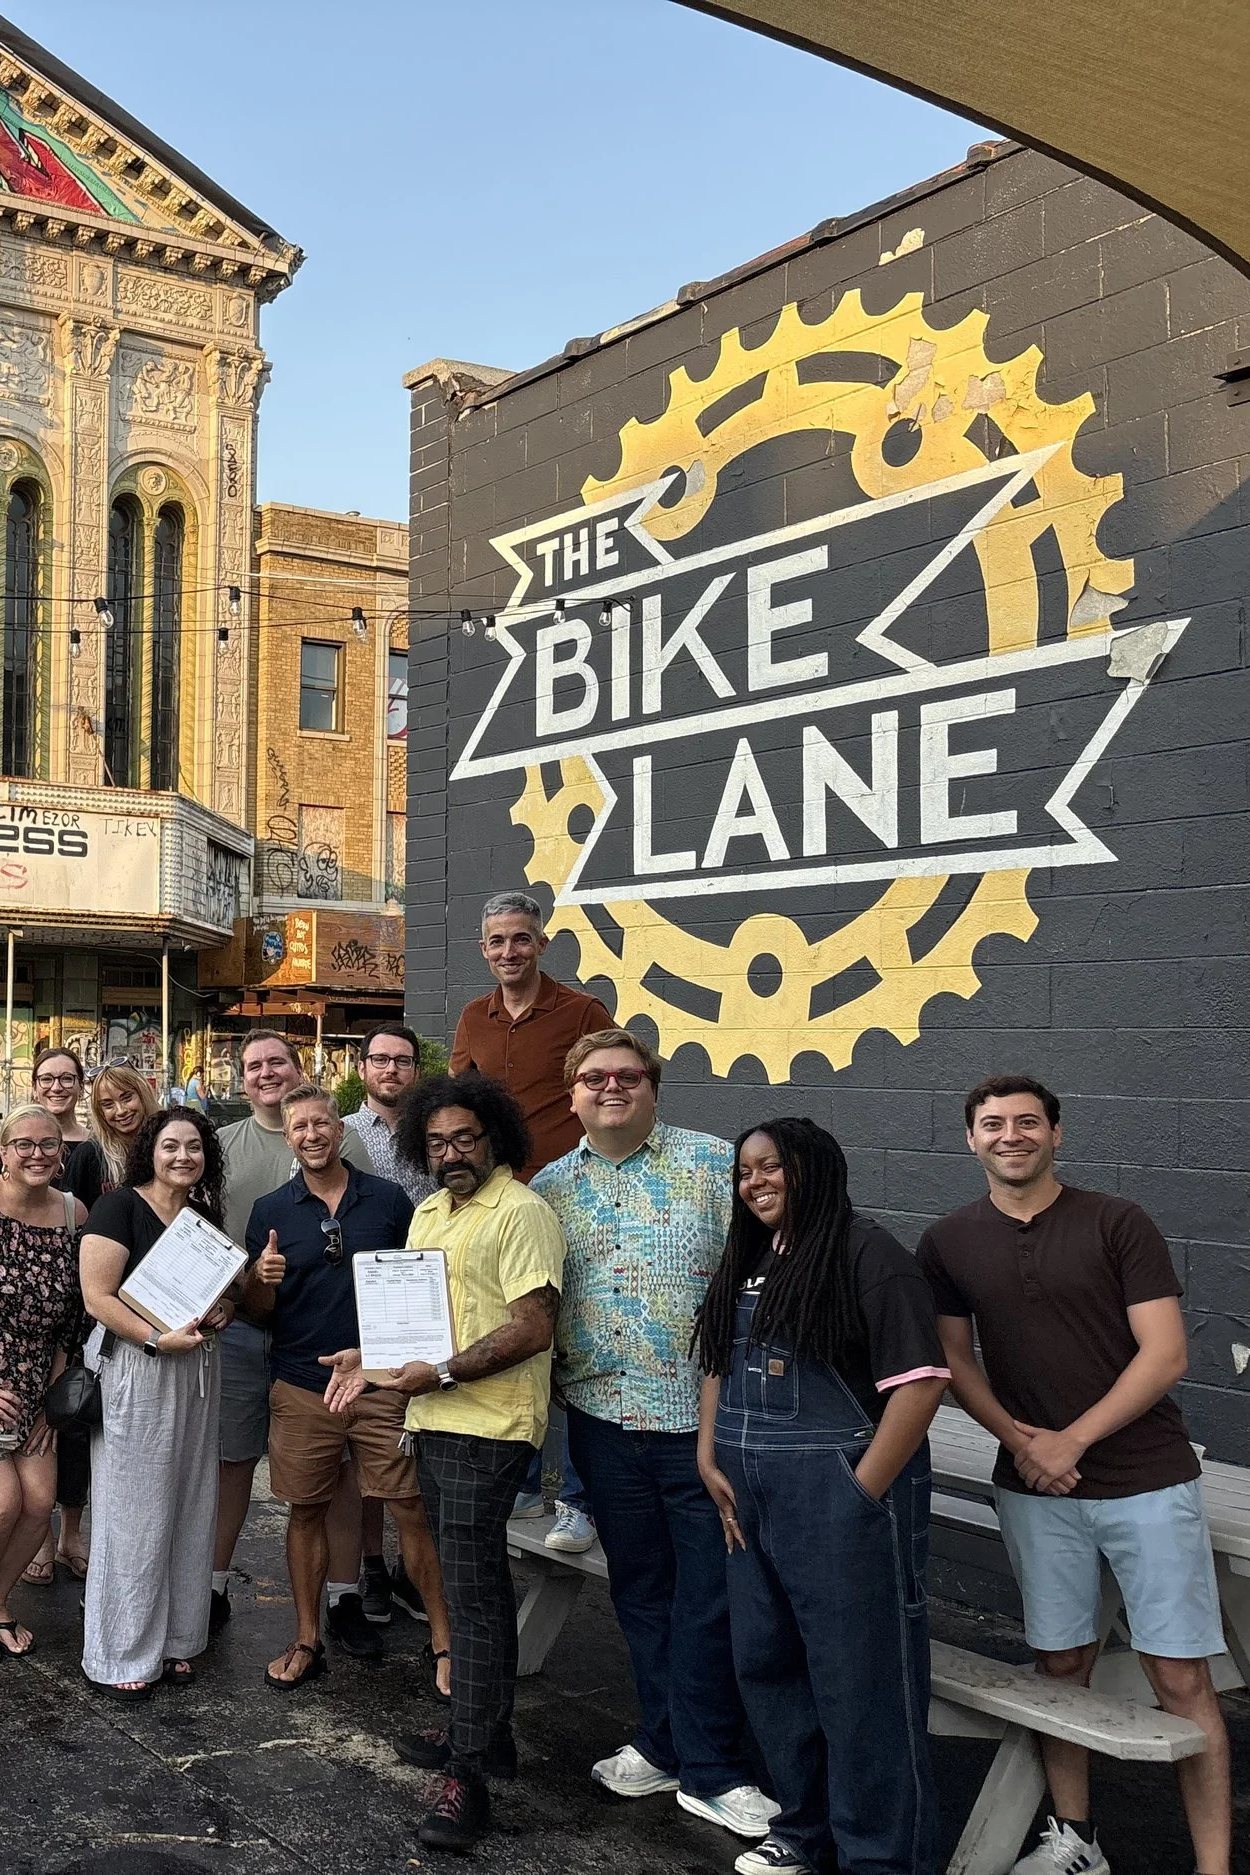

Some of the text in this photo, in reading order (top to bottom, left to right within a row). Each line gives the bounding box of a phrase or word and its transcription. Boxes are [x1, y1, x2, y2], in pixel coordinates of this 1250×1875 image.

[534, 545, 828, 737] BIKE
[536, 517, 619, 588] THE
[633, 688, 1019, 876] LANE
